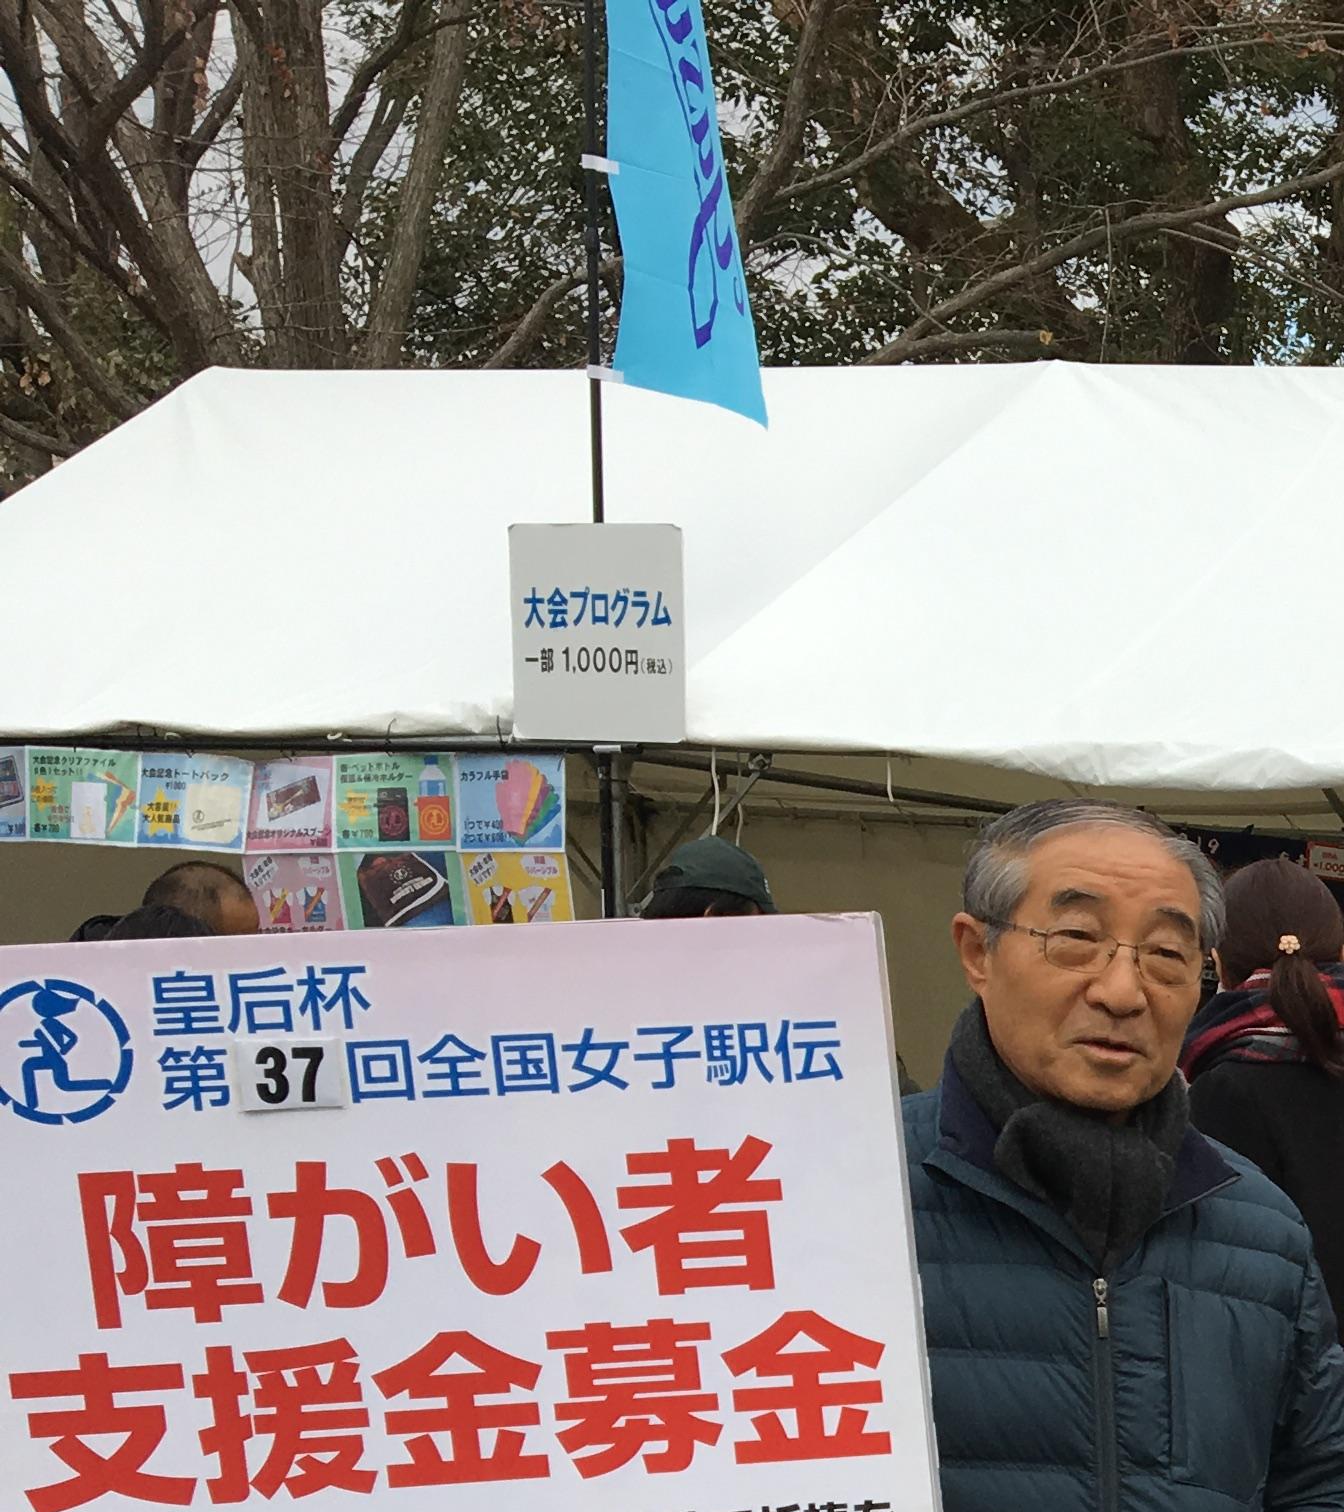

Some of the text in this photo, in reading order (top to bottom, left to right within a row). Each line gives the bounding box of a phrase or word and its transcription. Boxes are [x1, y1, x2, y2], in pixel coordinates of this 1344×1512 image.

[523, 586, 672, 629] 大会プログラム
[525, 648, 554, 673] 一部
[150, 965, 371, 1037] 皇后杯
[78, 1134, 785, 1331] 障がい者
